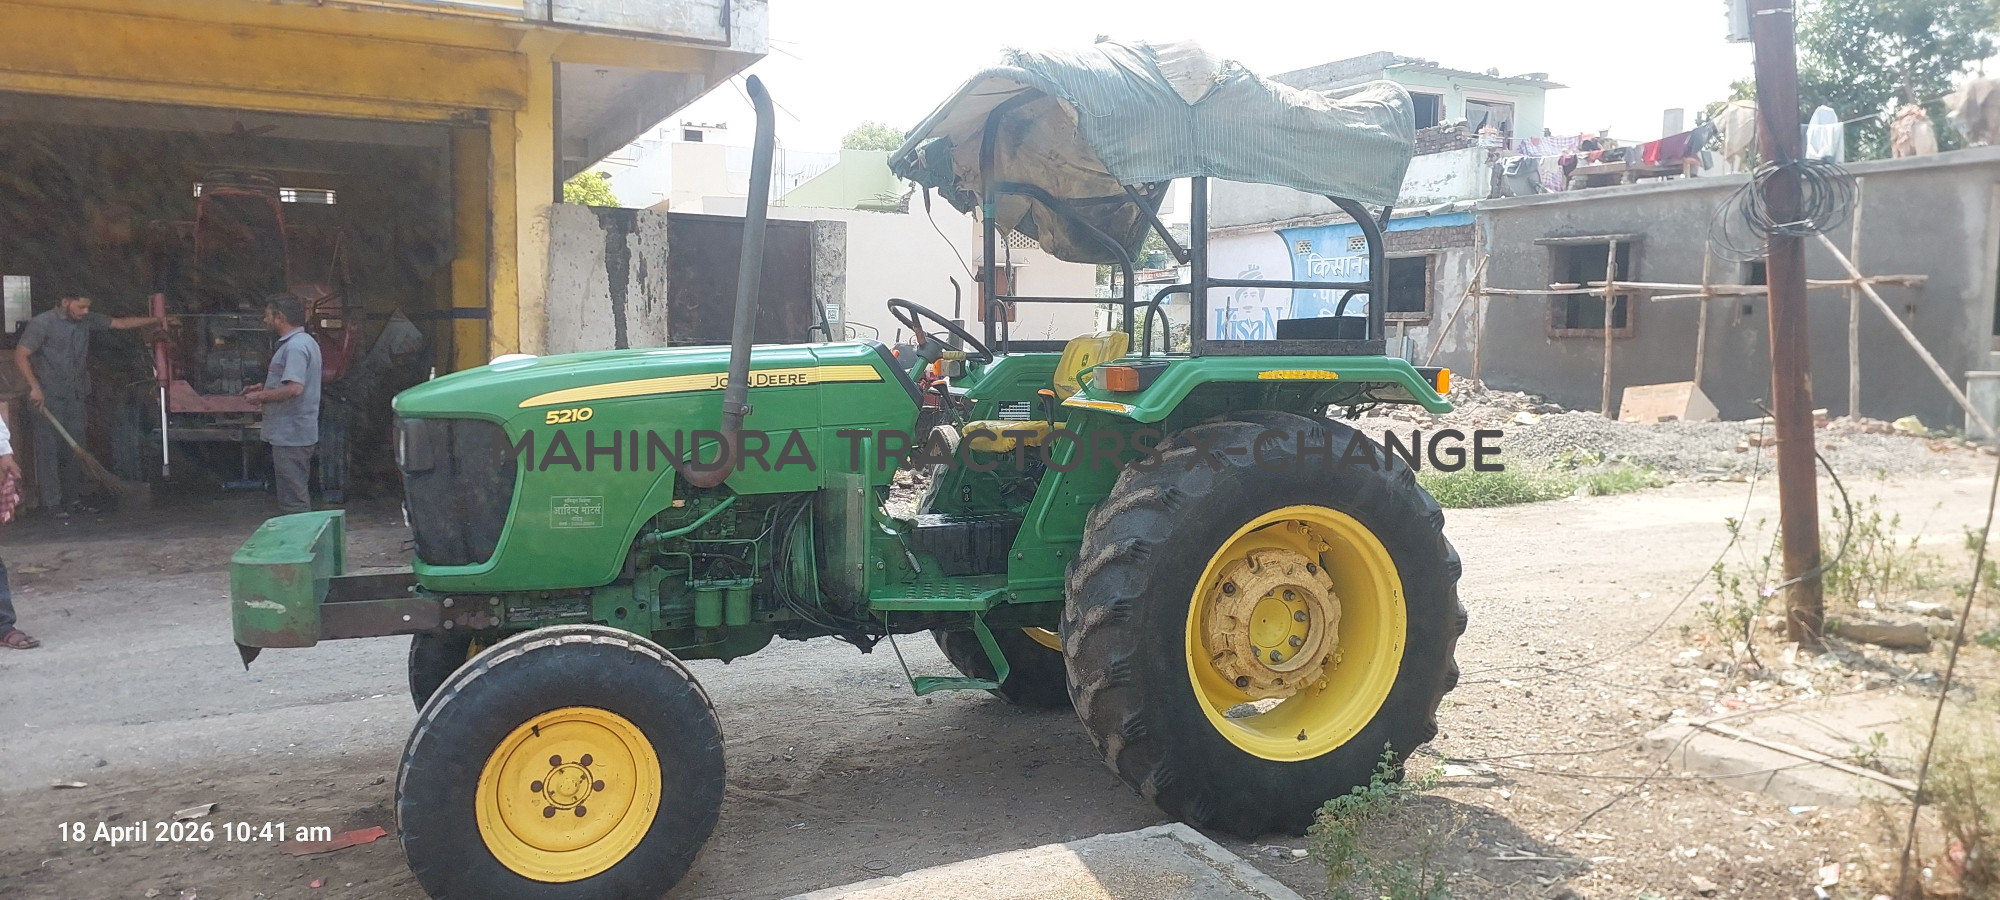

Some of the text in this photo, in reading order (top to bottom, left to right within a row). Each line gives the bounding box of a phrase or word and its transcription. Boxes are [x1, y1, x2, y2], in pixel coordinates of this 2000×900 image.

[1307, 252, 1364, 279] किसान
[756, 373, 807, 386] DEERE
[545, 407, 594, 425] 5210
